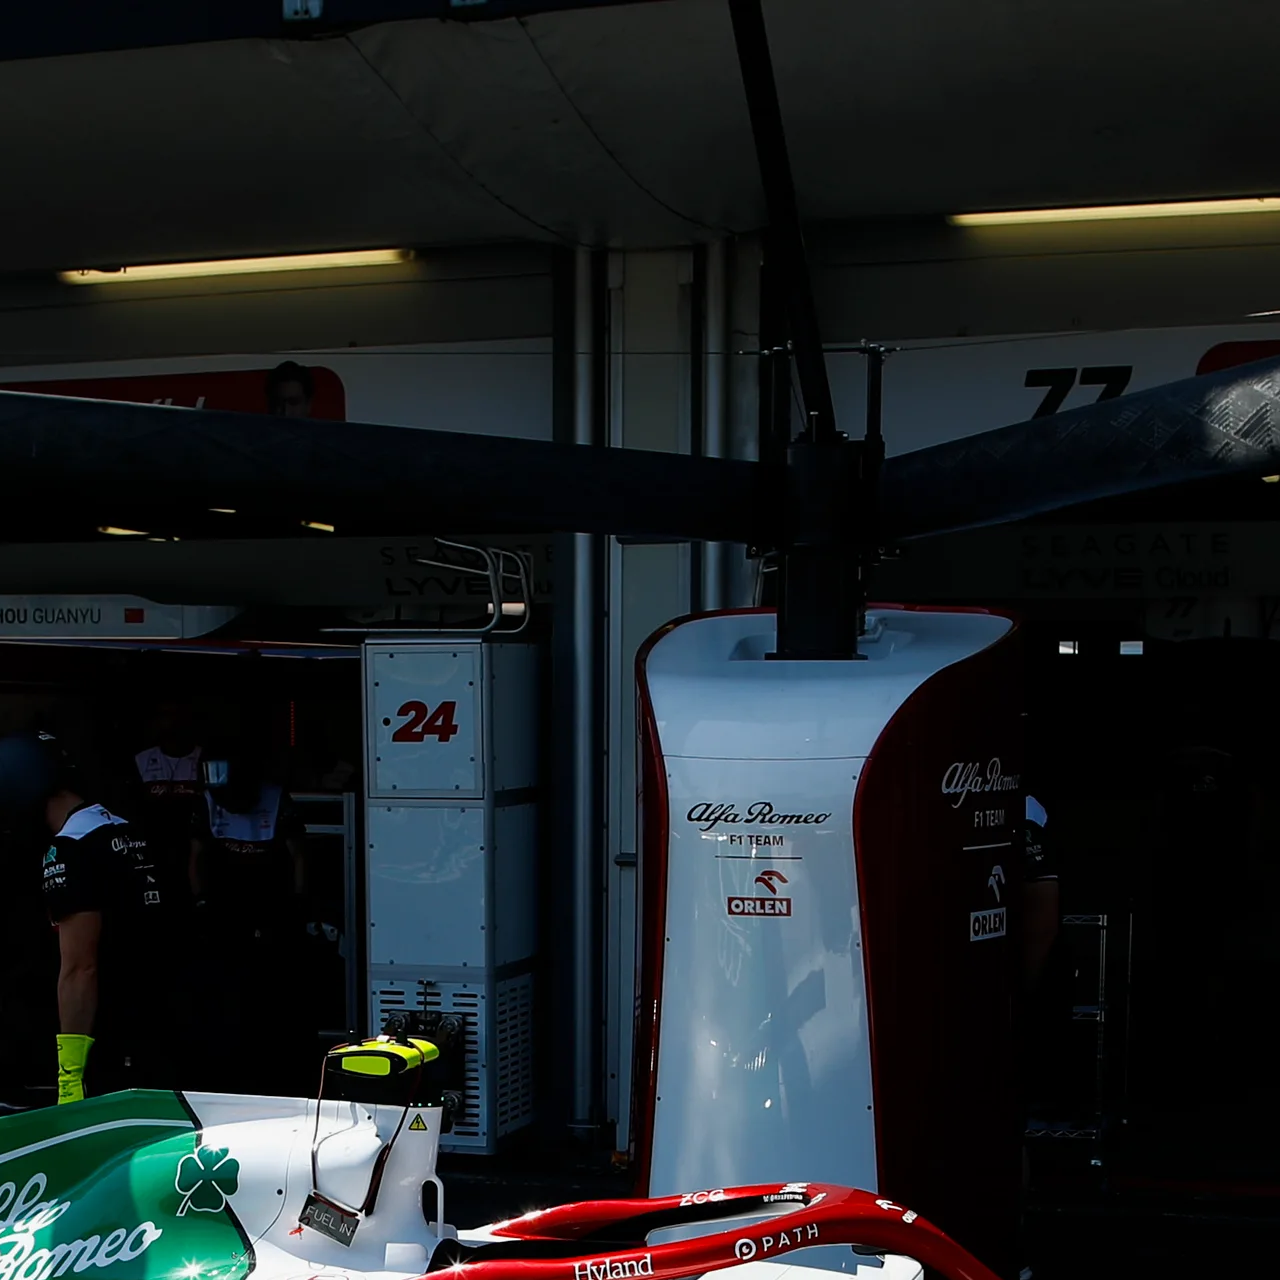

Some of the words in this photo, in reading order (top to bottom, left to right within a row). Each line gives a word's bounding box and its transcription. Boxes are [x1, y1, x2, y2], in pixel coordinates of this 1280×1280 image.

[1021, 532, 1231, 558] SEAGATE
[385, 577, 490, 596] LYVE
[1155, 565, 1231, 589] Cloud
[32, 607, 101, 625] GUANYU
[393, 701, 458, 742] 24
[942, 762, 985, 808] Alfa
[687, 802, 742, 831] Alfa
[742, 801, 832, 826] Romeo
[974, 811, 984, 828] F1
[985, 809, 1006, 828] TEAM
[729, 834, 745, 846] F1
[748, 834, 784, 846] TEAM
[731, 899, 789, 914] ORLEN
[972, 911, 1005, 937] ORLEN
[678, 1188, 726, 1207] ZCG
[305, 1205, 337, 1230] FUEL
[339, 1222, 354, 1238] IN
[762, 1223, 819, 1252] PATH
